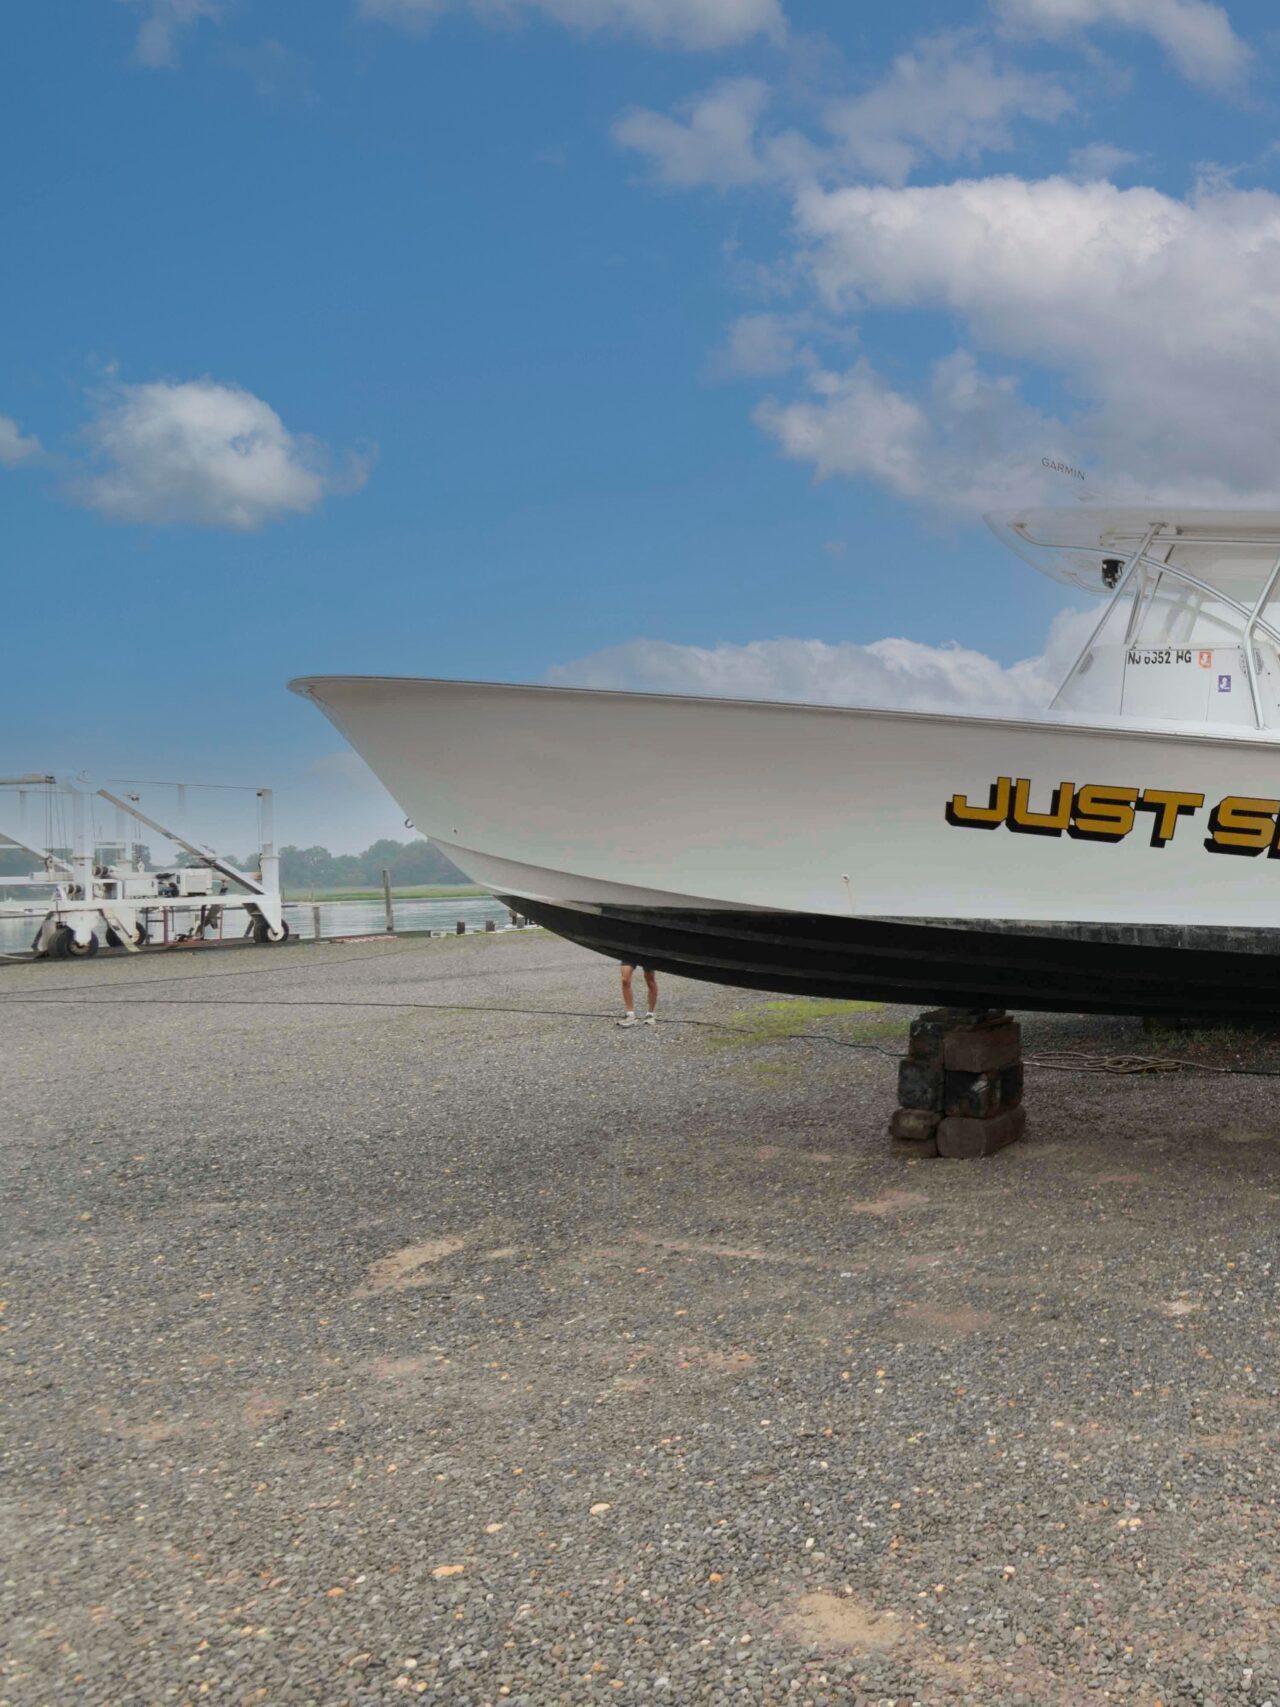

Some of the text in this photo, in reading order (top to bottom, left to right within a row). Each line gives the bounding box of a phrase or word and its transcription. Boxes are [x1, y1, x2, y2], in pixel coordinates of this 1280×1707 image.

[1041, 457, 1085, 481] GARMIN
[1127, 651, 1142, 665] NJ
[1176, 650, 1192, 664] HG
[945, 777, 1205, 848] JUST
